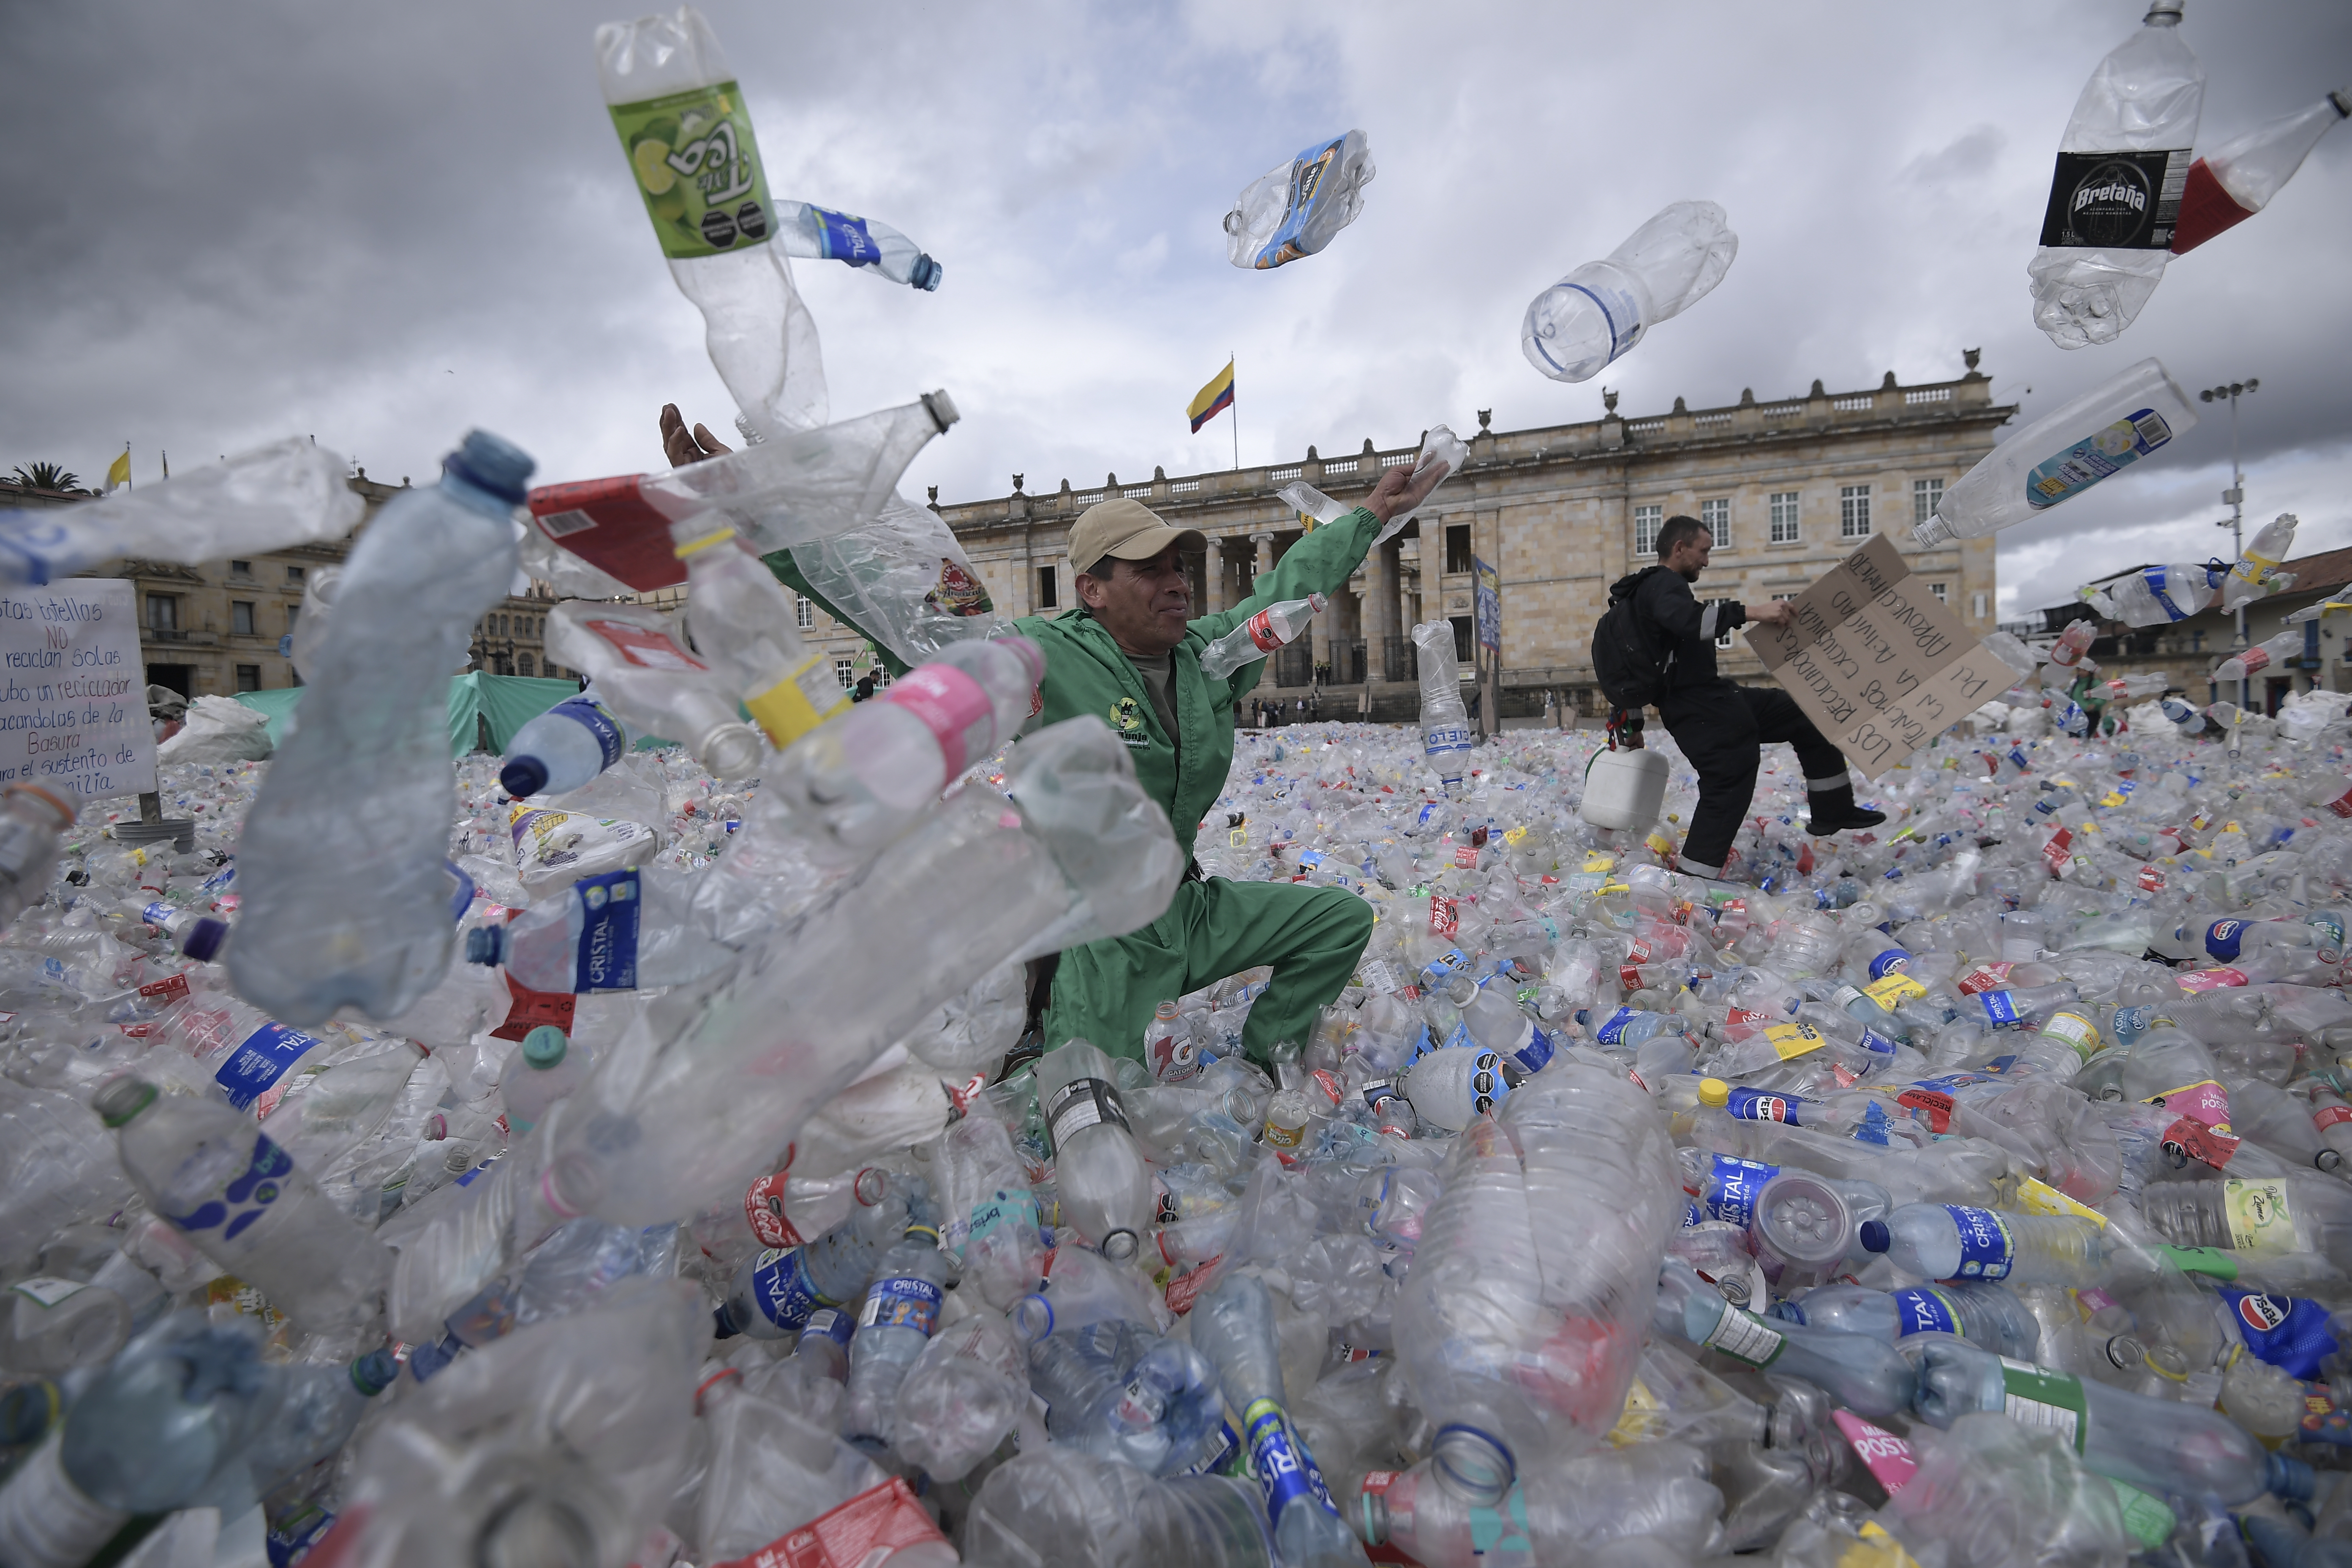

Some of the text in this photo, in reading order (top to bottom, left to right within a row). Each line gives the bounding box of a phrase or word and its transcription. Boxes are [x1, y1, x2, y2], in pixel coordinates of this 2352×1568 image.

[2074, 183, 2145, 212] Bretaña
[35, 597, 103, 622] botellas
[45, 625, 68, 650] NO
[5, 651, 62, 669] reciclan
[1833, 591, 1944, 720] EN LA ACTIVIDAD
[37, 682, 54, 701] un
[57, 670, 131, 699] reciclador
[1776, 627, 1891, 765] LOS RECICLADORES
[83, 708, 100, 724] de
[108, 702, 123, 724] la
[1860, 679, 1927, 750] TENEMOS
[27, 731, 81, 755] Basura
[1429, 730, 1470, 744] CIELO
[21, 760, 33, 776] el
[41, 748, 107, 776] sustento
[116, 743, 136, 764] de
[553, 853, 569, 865] 3000
[2219, 921, 2236, 939] PEPSI
[589, 915, 610, 984] CRISTAL
[1988, 994, 2004, 1019] CRISTAL
[2115, 1010, 2126, 1035] AGUA
[238, 1054, 248, 1063] VIDA
[1760, 1097, 1770, 1121] PEPS
[1904, 1092, 1952, 1113] RECICLAME
[2262, 1185, 2277, 1200] Deli
[752, 1175, 787, 1244] Coca-Cola
[2253, 1194, 2265, 1222] Zumo
[1965, 1202, 1991, 1248] CRISTA
[892, 1279, 935, 1299] CRISTAL
[2255, 1296, 2280, 1326] PEPSI
